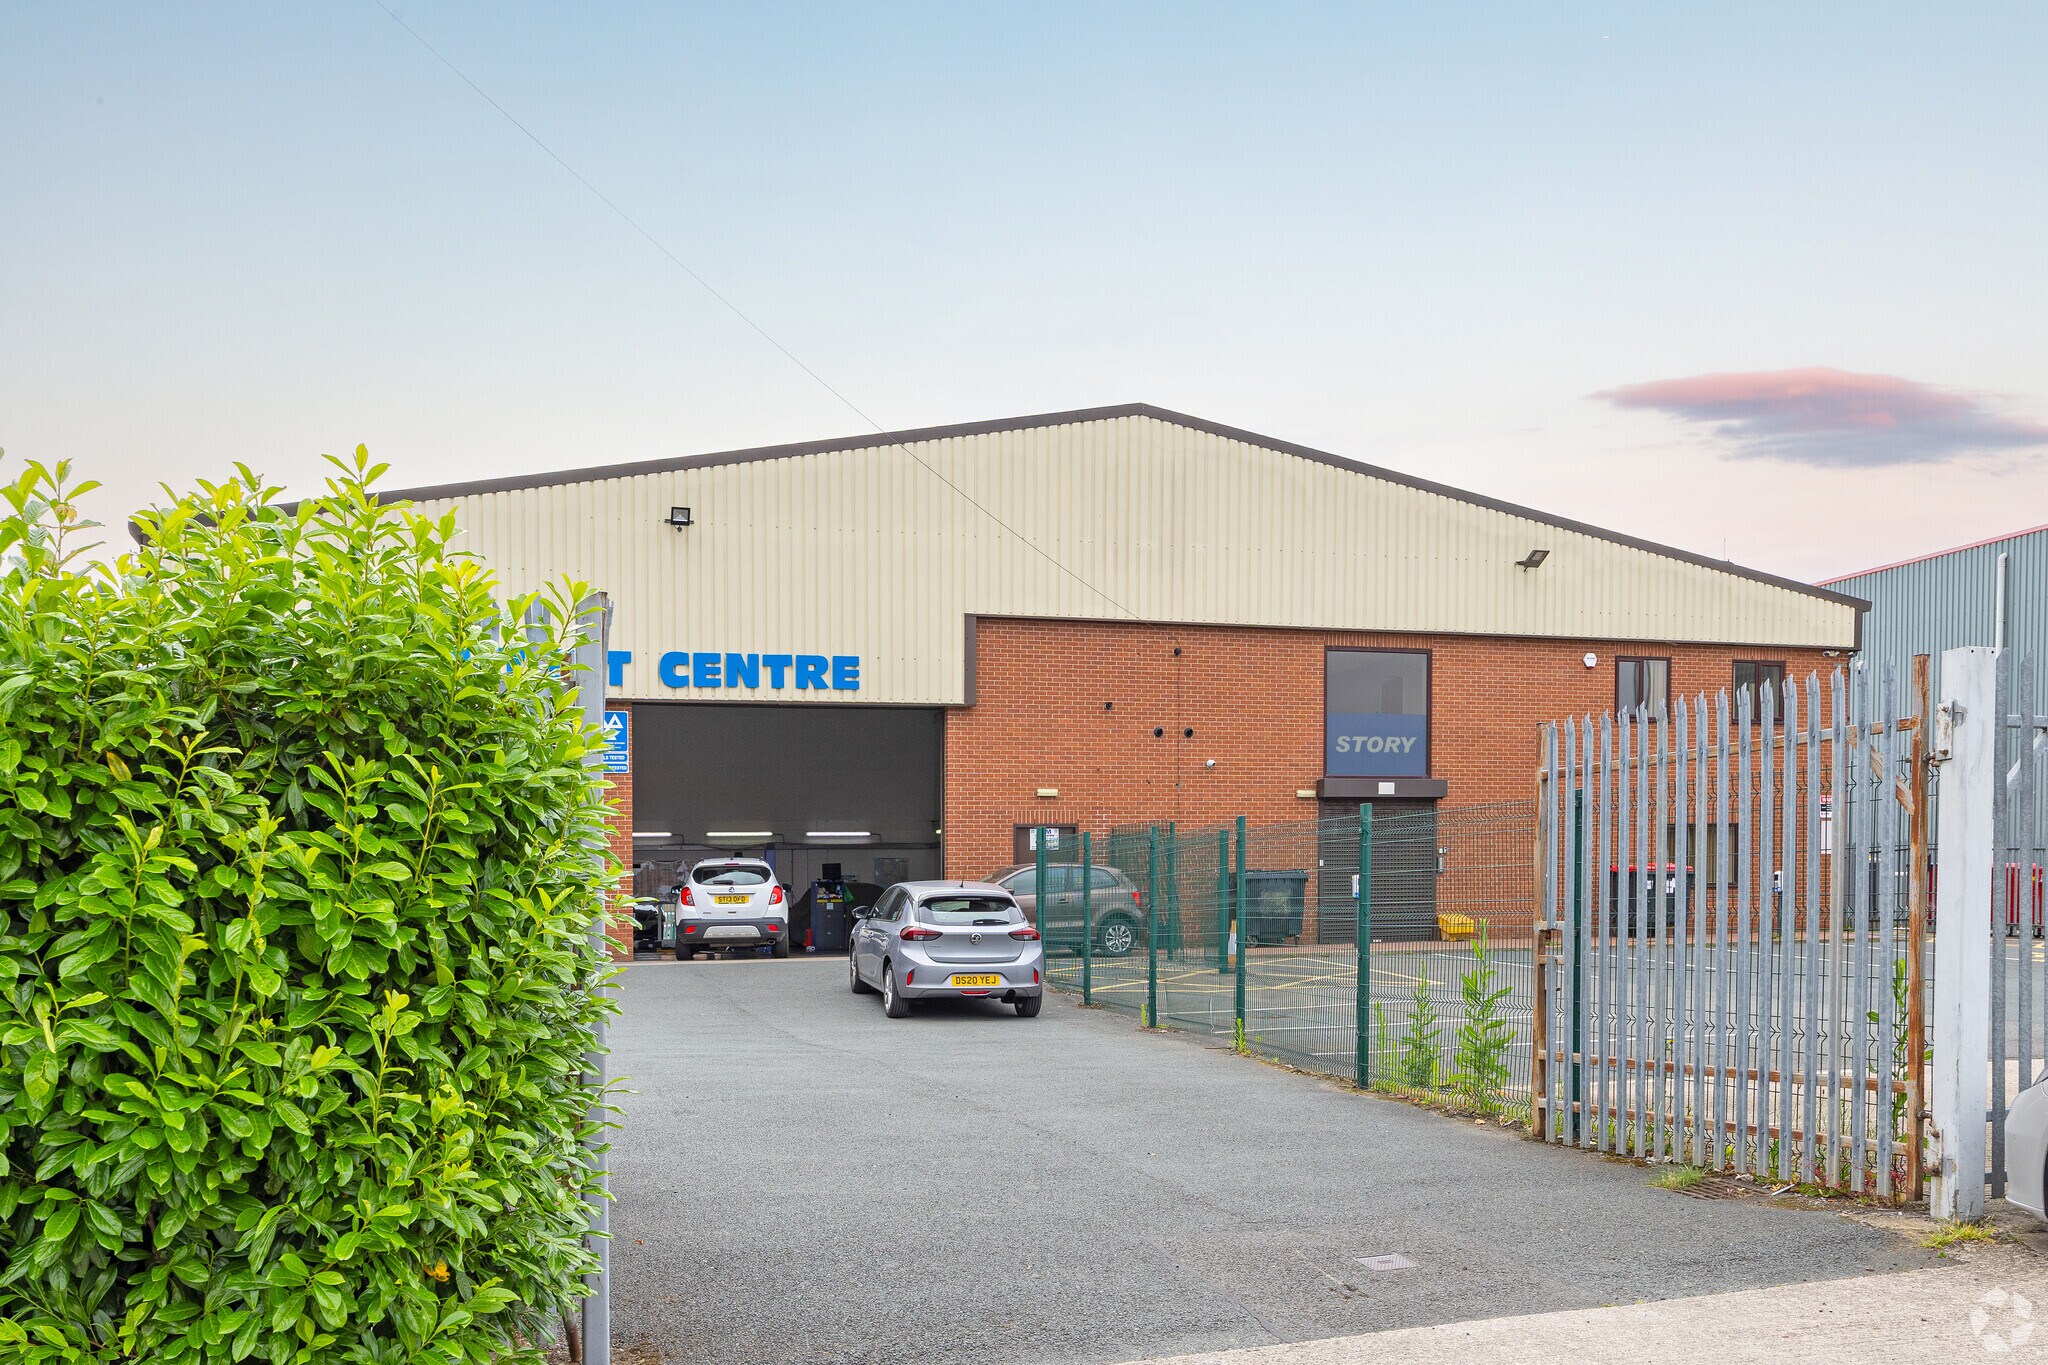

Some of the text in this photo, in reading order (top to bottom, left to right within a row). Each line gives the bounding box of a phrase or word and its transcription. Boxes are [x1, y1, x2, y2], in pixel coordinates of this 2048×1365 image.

[659, 651, 860, 690] CENTRE
[1335, 735, 1418, 753] STORY
[955, 976, 996, 984] DS20 YEJ
